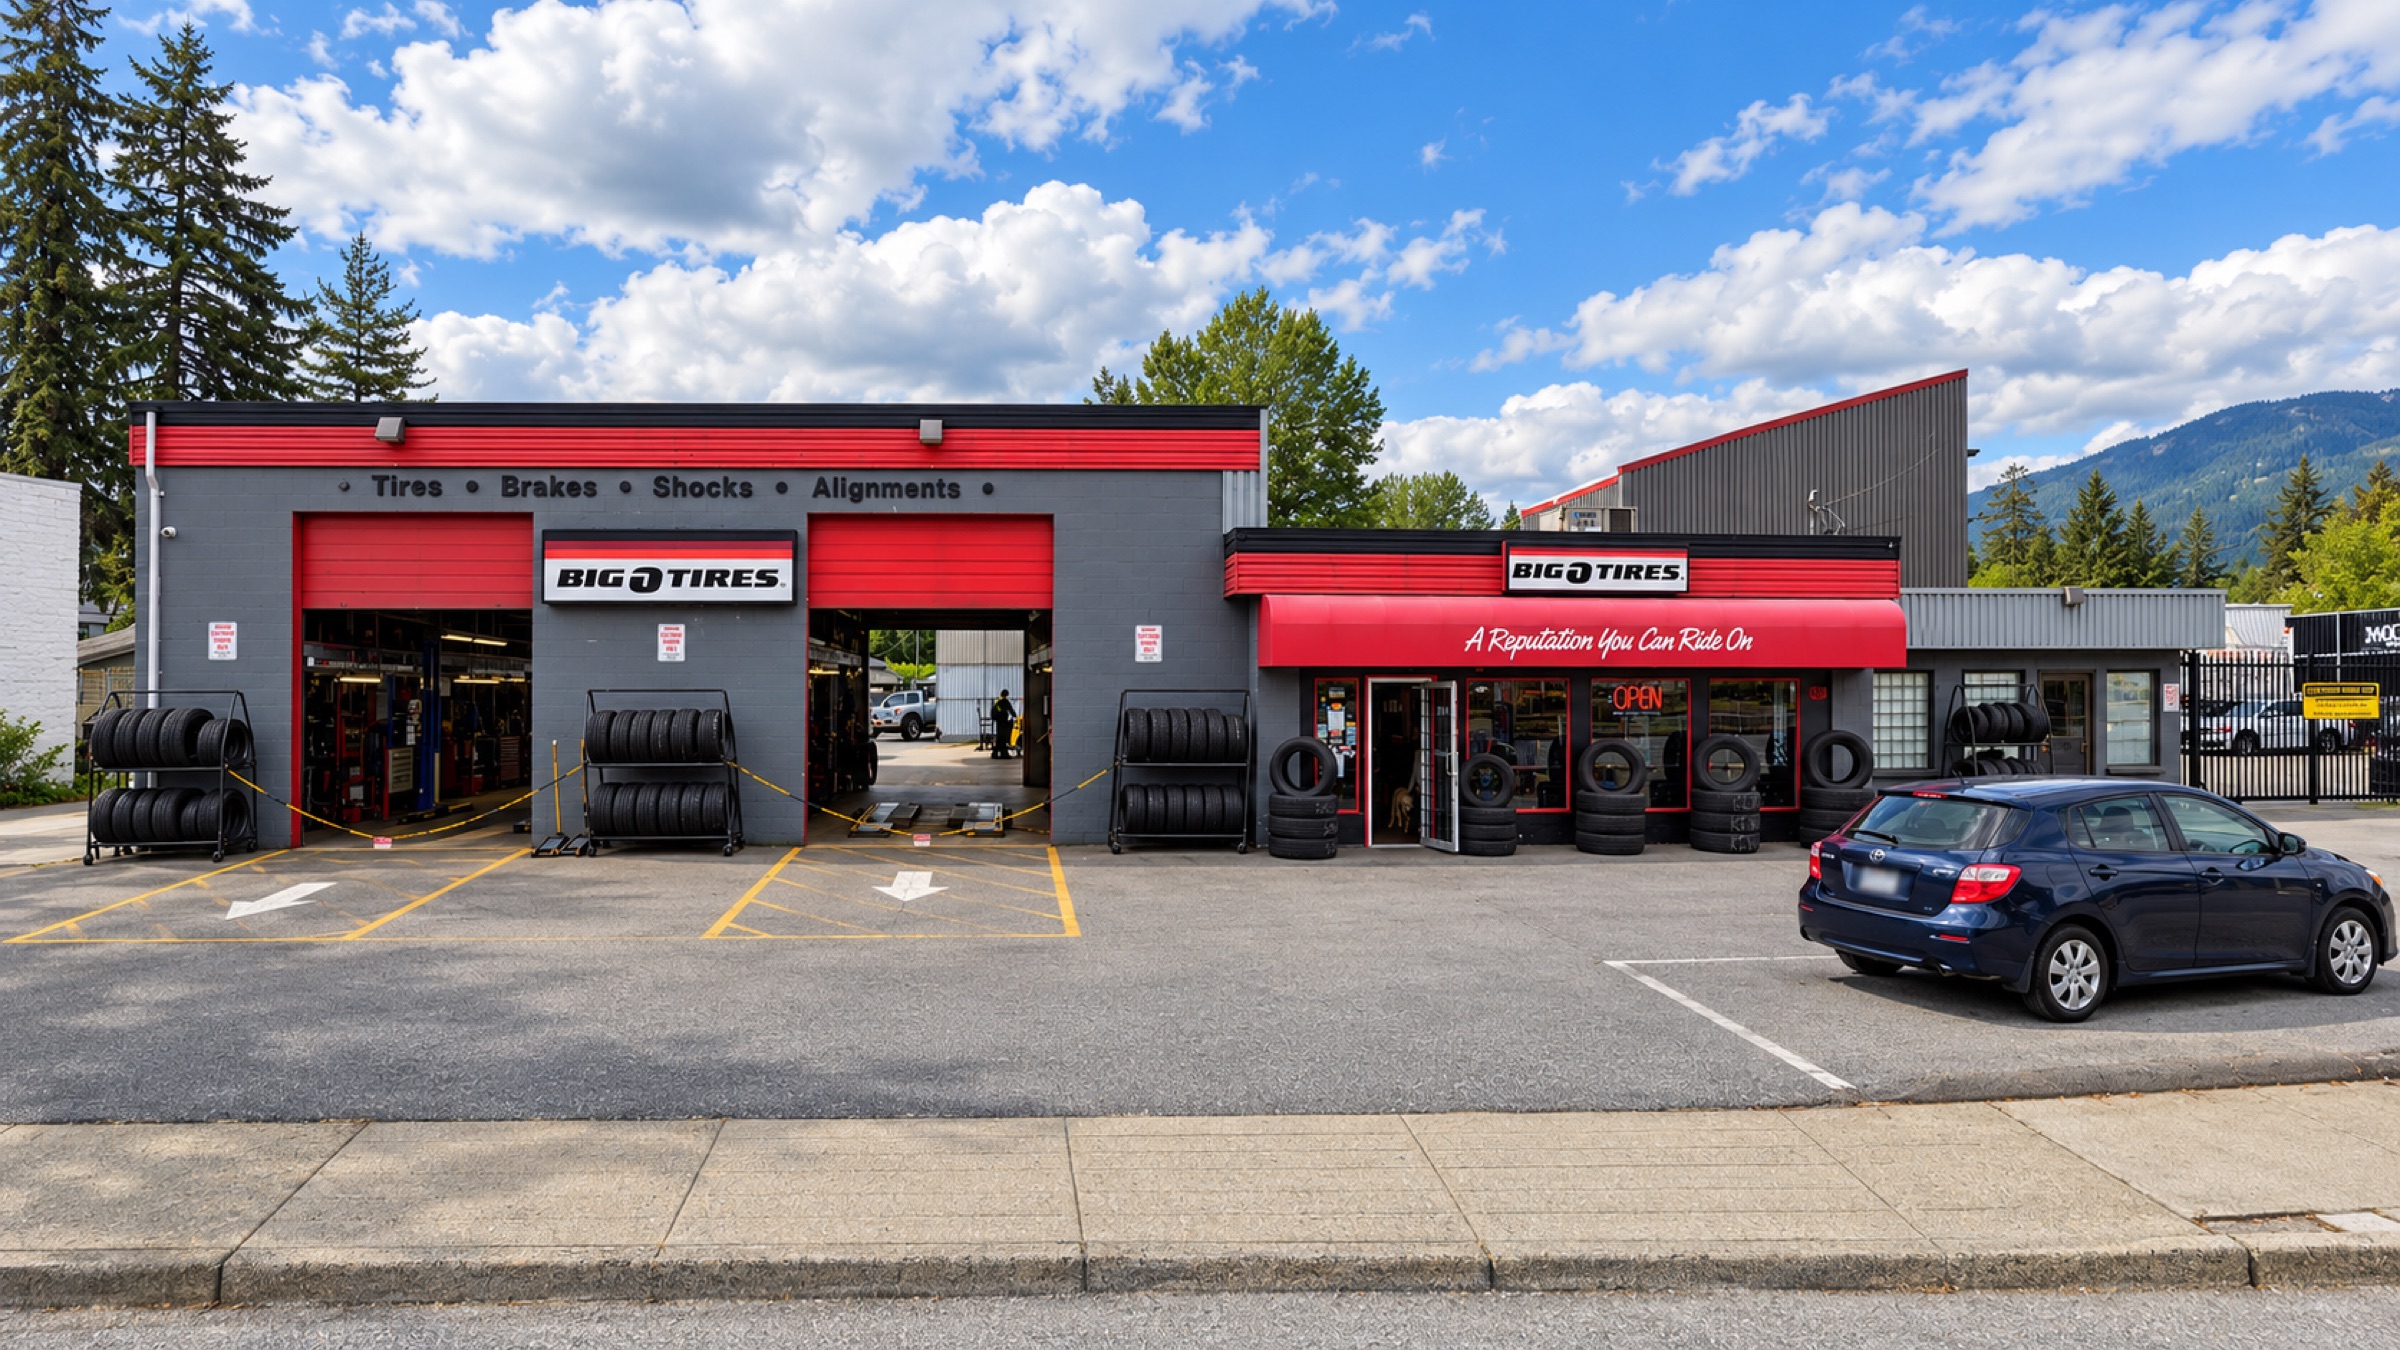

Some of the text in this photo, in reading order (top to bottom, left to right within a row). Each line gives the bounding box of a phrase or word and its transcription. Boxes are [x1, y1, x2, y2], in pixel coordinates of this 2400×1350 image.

[372, 475, 961, 502] Tires Brakes Shocks Alignments
[557, 568, 625, 588] BIG
[667, 568, 779, 588] TIRES
[1512, 563, 1564, 579] BIG
[1596, 564, 1681, 580] TIRES
[1464, 626, 1753, 660] A Reputation You Can Ride On
[1613, 685, 1663, 710] OPEN
